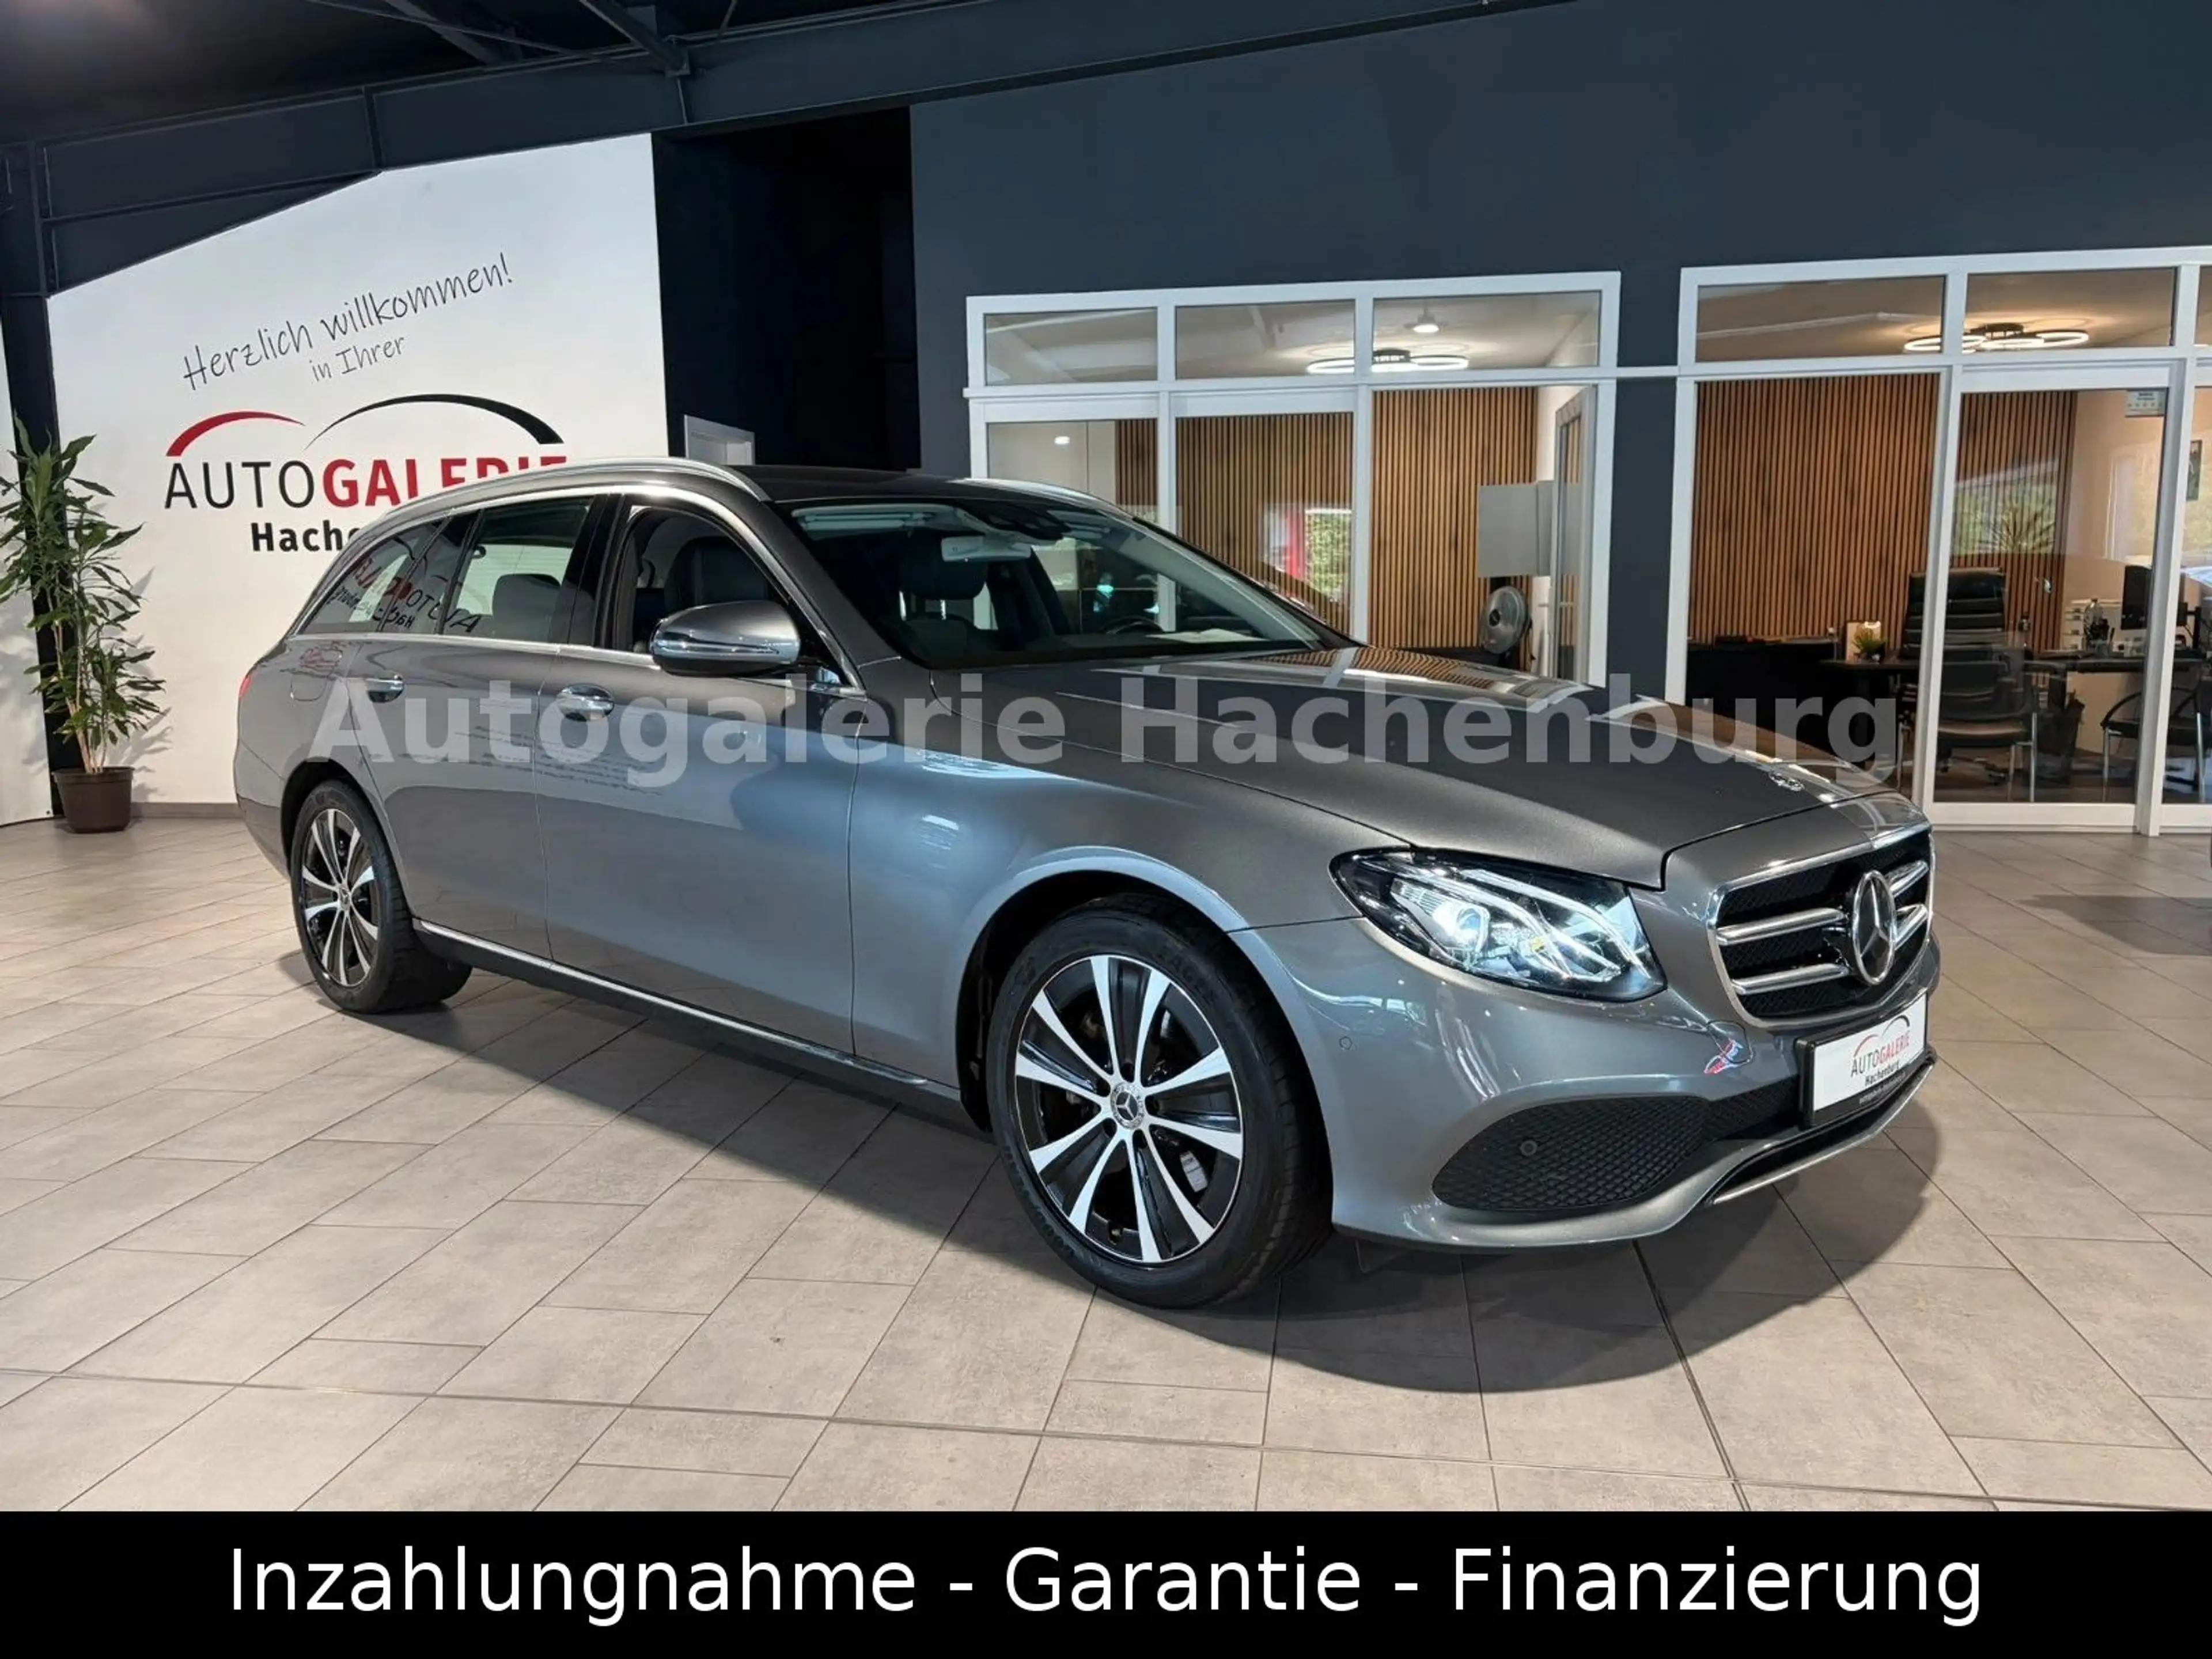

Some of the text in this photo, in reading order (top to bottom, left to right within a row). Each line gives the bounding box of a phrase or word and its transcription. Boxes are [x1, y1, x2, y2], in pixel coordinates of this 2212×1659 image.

[183, 252, 513, 390] Herzlich willkommen!
[312, 336, 406, 381] in Ihrer
